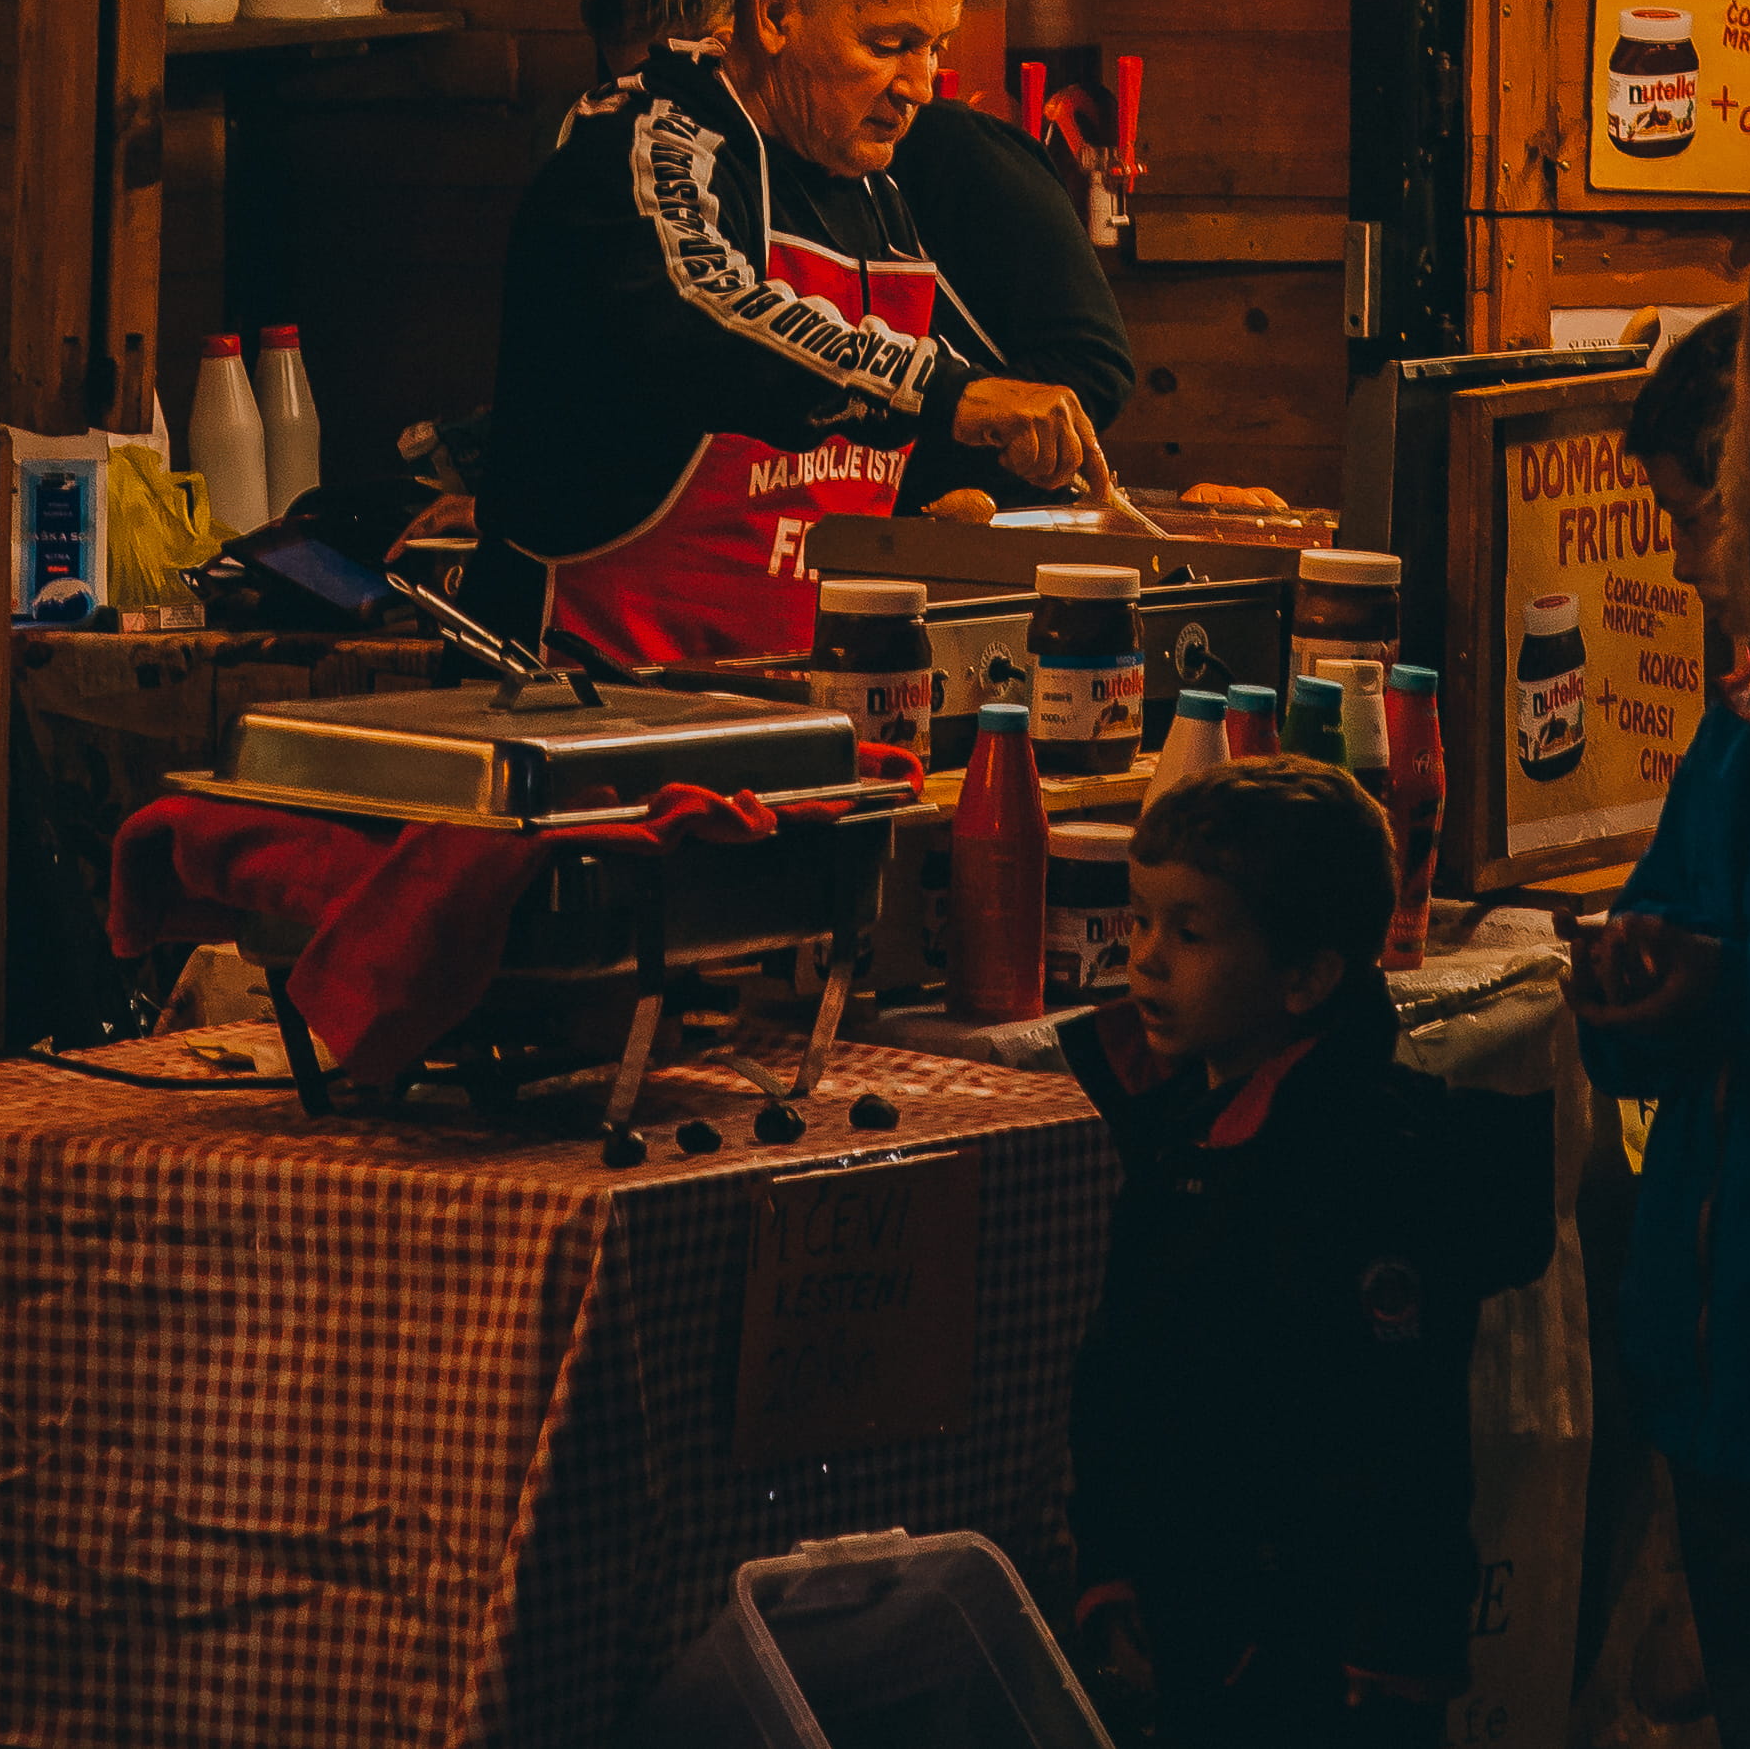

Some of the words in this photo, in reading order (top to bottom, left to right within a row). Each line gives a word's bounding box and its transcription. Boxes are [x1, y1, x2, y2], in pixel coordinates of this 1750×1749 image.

[1628, 75, 1696, 105] nutella
[748, 444, 864, 498] NAJBOLJE
[1602, 604, 1657, 640] MRVICE
[1638, 650, 1699, 692] KOKOS
[1618, 700, 1675, 741] ORASI
